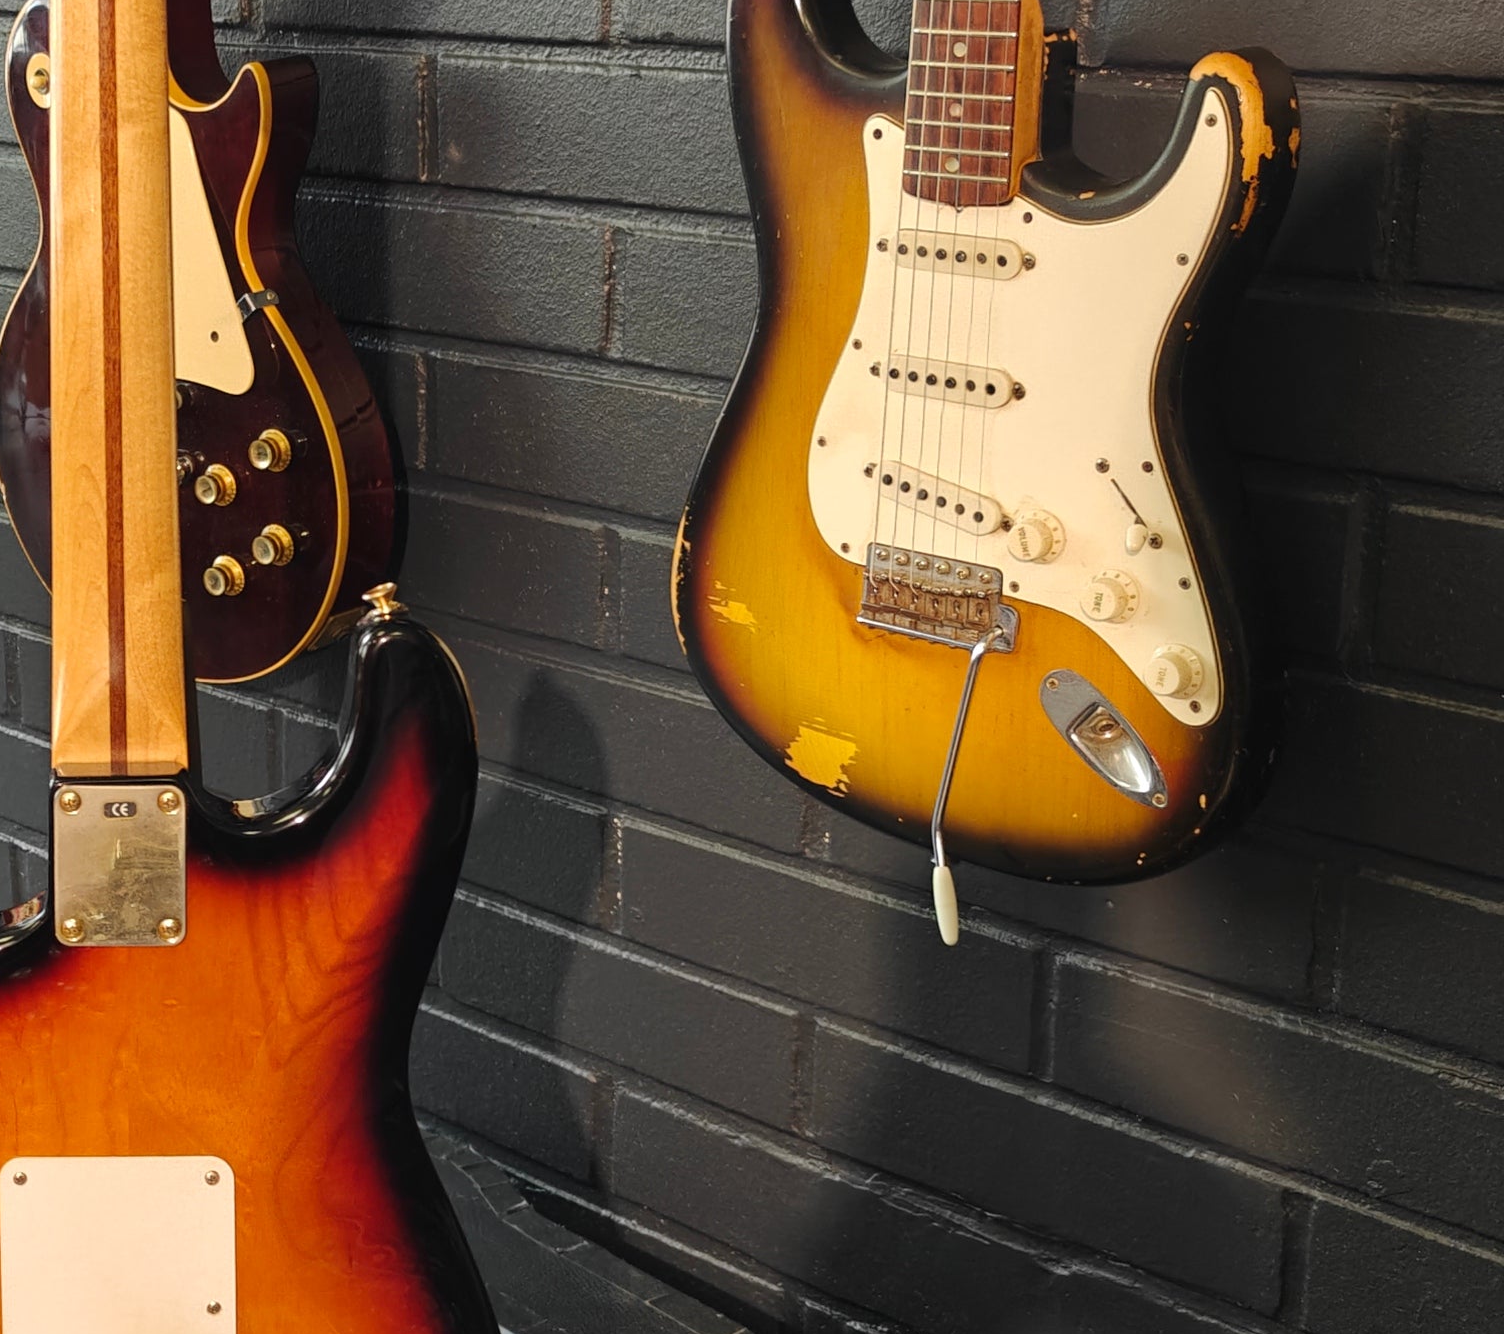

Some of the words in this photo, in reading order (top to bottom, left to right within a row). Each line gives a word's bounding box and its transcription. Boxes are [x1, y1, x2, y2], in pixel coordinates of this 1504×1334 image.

[1017, 526, 1031, 557] VOLUME
[1091, 592, 1104, 613] TONE
[111, 803, 129, 816] CE
